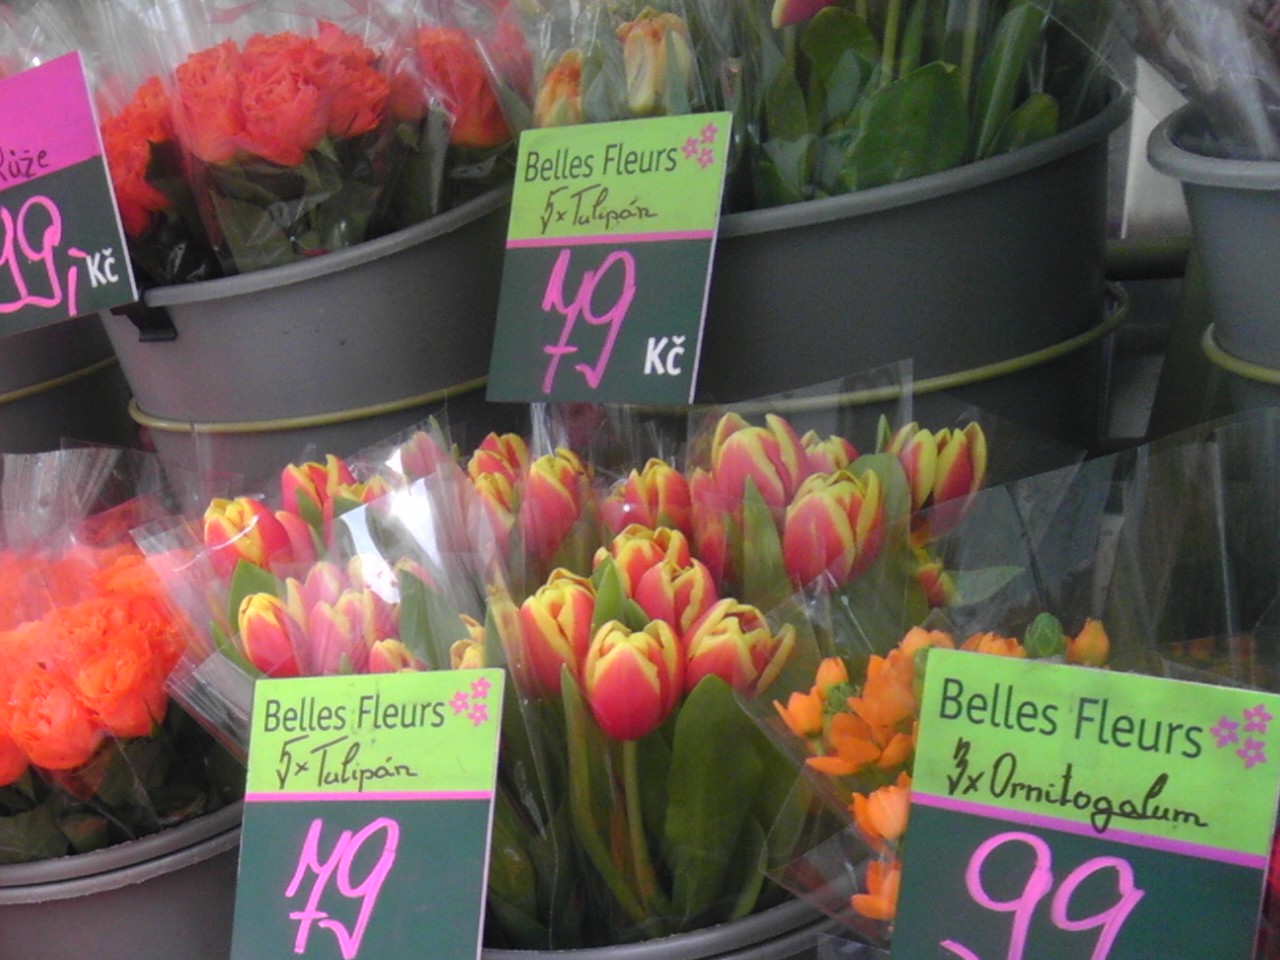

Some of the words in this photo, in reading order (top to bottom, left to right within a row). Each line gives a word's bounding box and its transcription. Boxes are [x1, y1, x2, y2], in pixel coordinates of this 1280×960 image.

[524, 149, 594, 182] Belles
[602, 143, 678, 176] Fleurs
[570, 184, 658, 230] Tulipán
[86, 247, 118, 287] Kč
[644, 335, 686, 375] Kč
[264, 697, 346, 733] Belles
[357, 694, 445, 729] Fleurs
[939, 677, 1060, 736] Belles
[1075, 697, 1204, 759] Fleurs
[310, 736, 418, 792] Tulipán
[989, 752, 1208, 833] Ornitogalum
